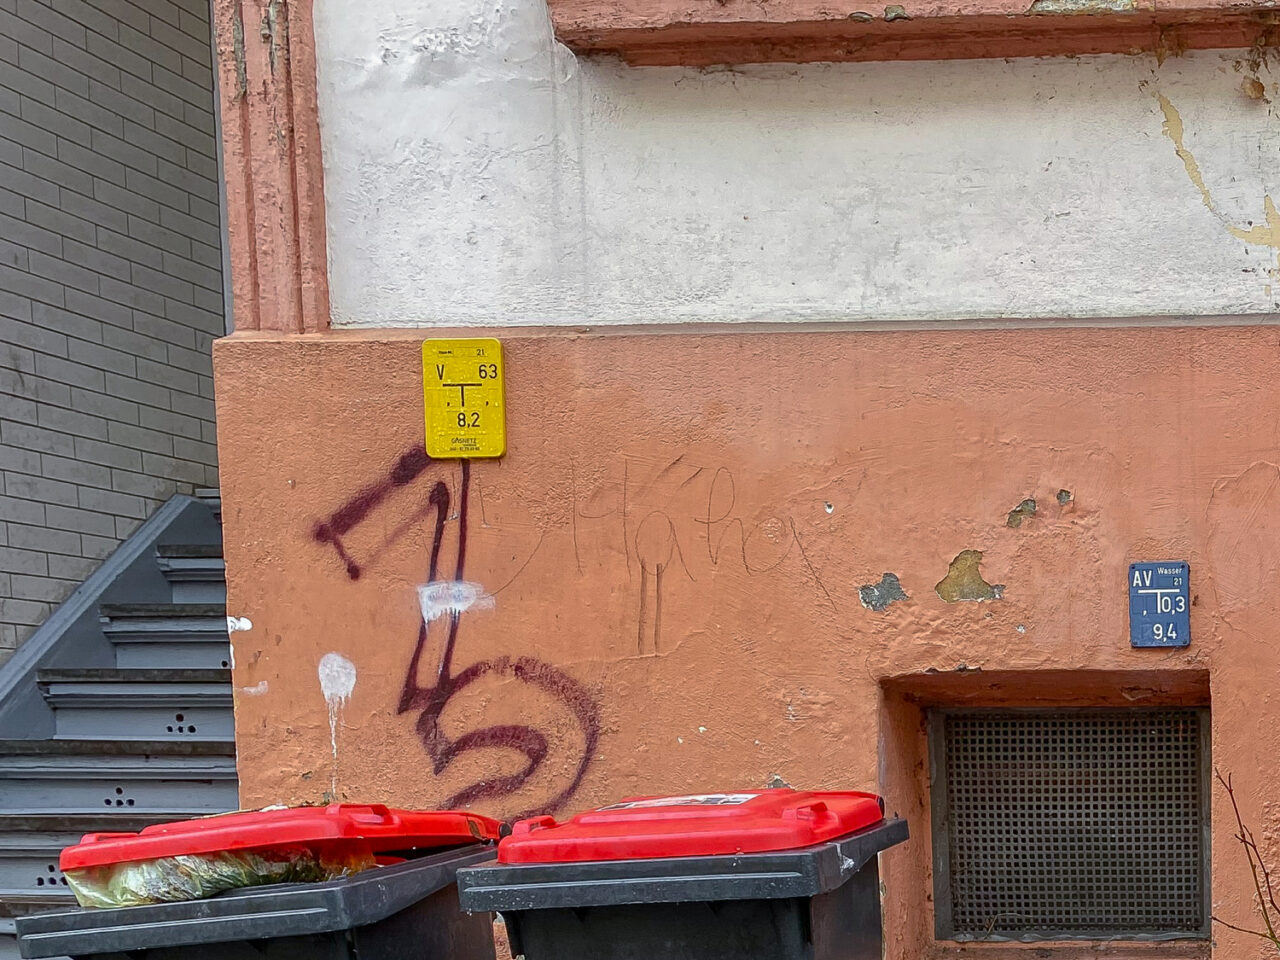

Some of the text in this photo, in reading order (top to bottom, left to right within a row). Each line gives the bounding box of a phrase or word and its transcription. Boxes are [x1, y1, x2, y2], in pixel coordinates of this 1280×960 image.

[436, 364, 498, 380] V 63
[457, 411, 480, 429] 8,2
[1132, 570, 1153, 587] AV
[1157, 567, 1183, 575] Wasser
[1173, 577, 1183, 586] 21
[1161, 596, 1186, 615] 0,3
[1152, 623, 1178, 642] 9,4
